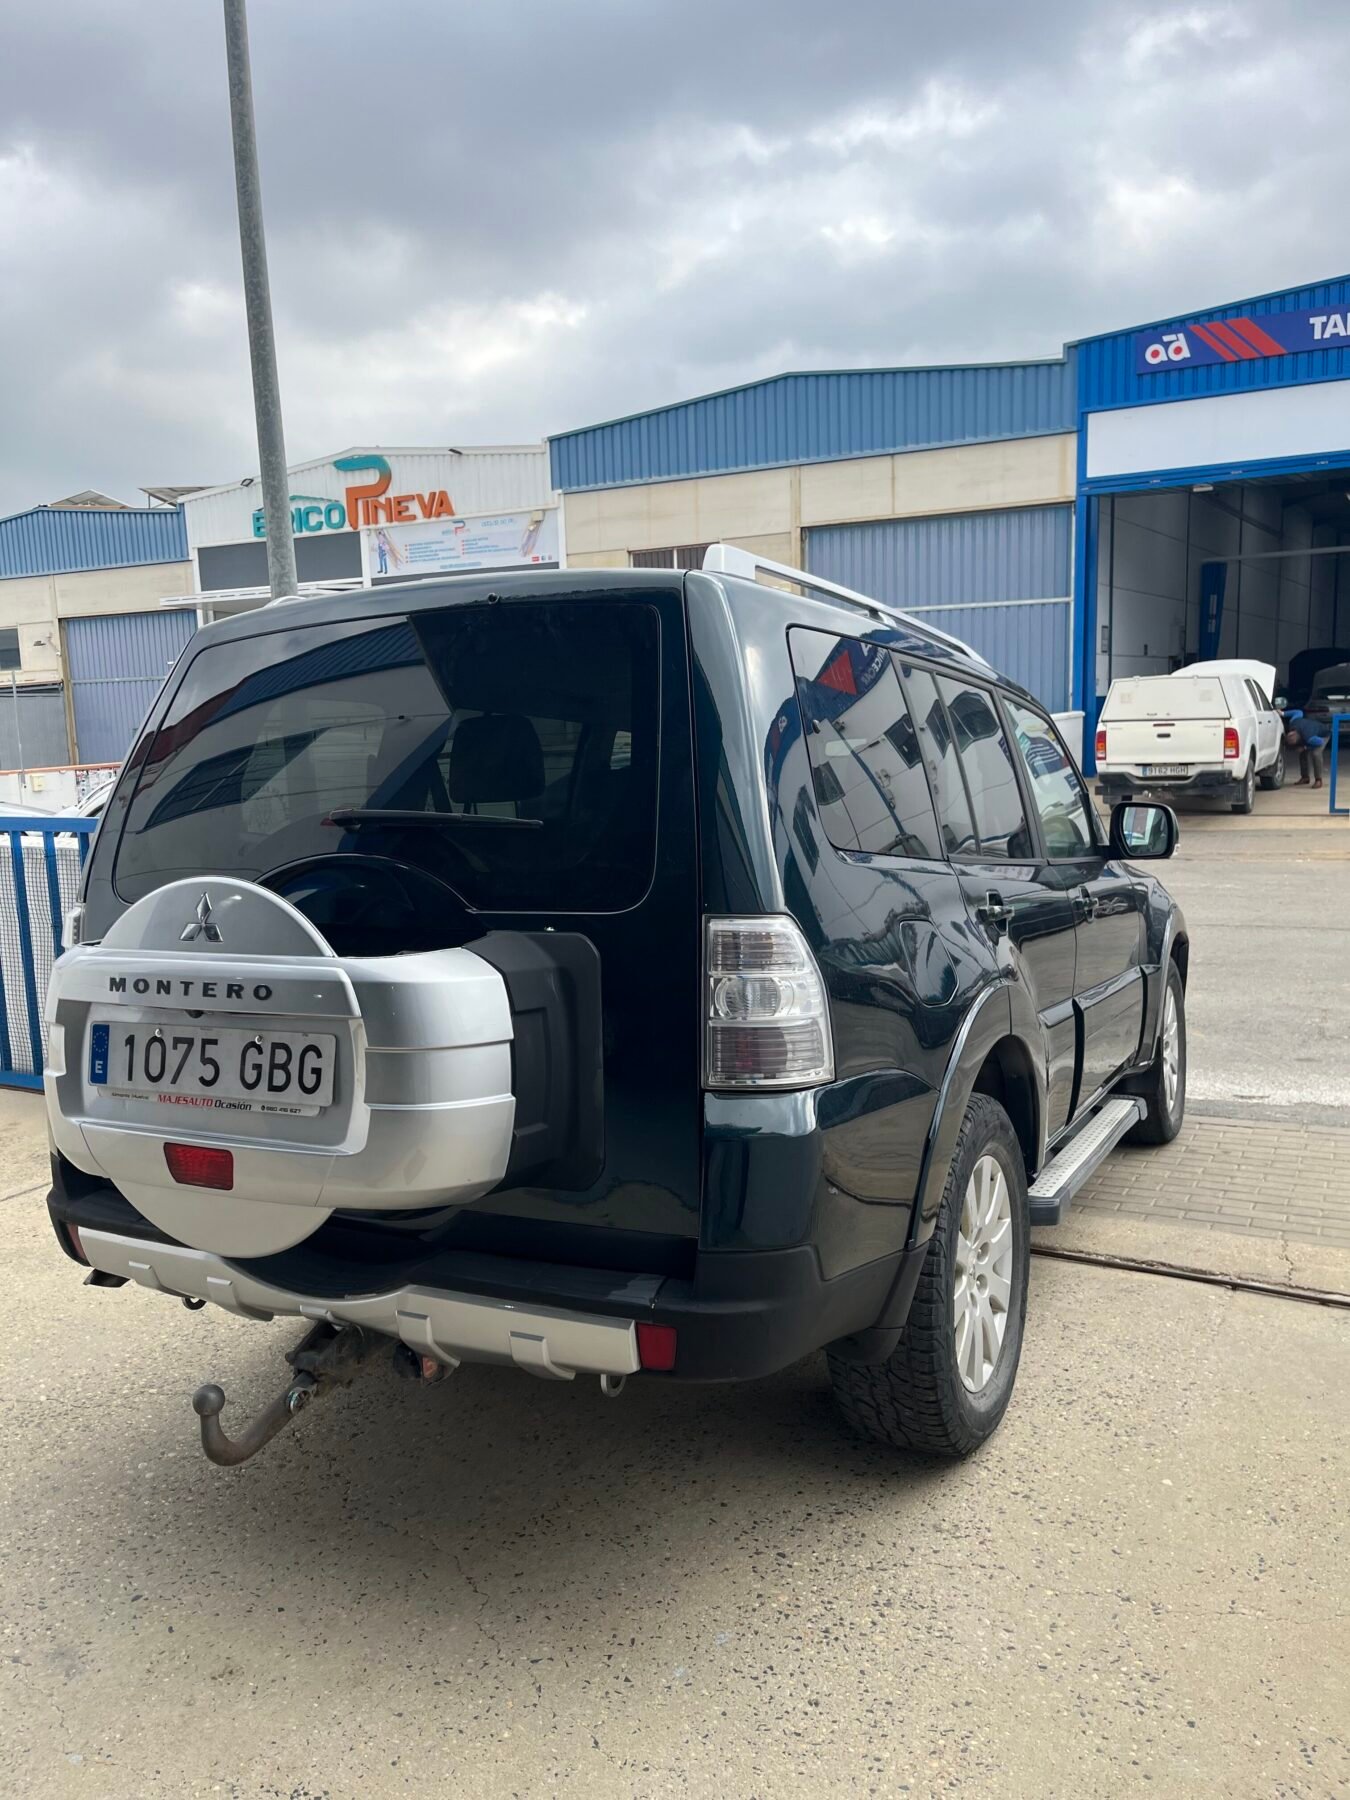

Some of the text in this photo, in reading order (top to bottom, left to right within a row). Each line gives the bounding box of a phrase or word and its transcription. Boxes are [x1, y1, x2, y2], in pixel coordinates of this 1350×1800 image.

[109, 977, 273, 1001] MONTERO
[94, 1034, 323, 1095] E 1075 GBG
[158, 1094, 214, 1107] MAJESAUTO
[214, 1099, 252, 1111] Ocasión
